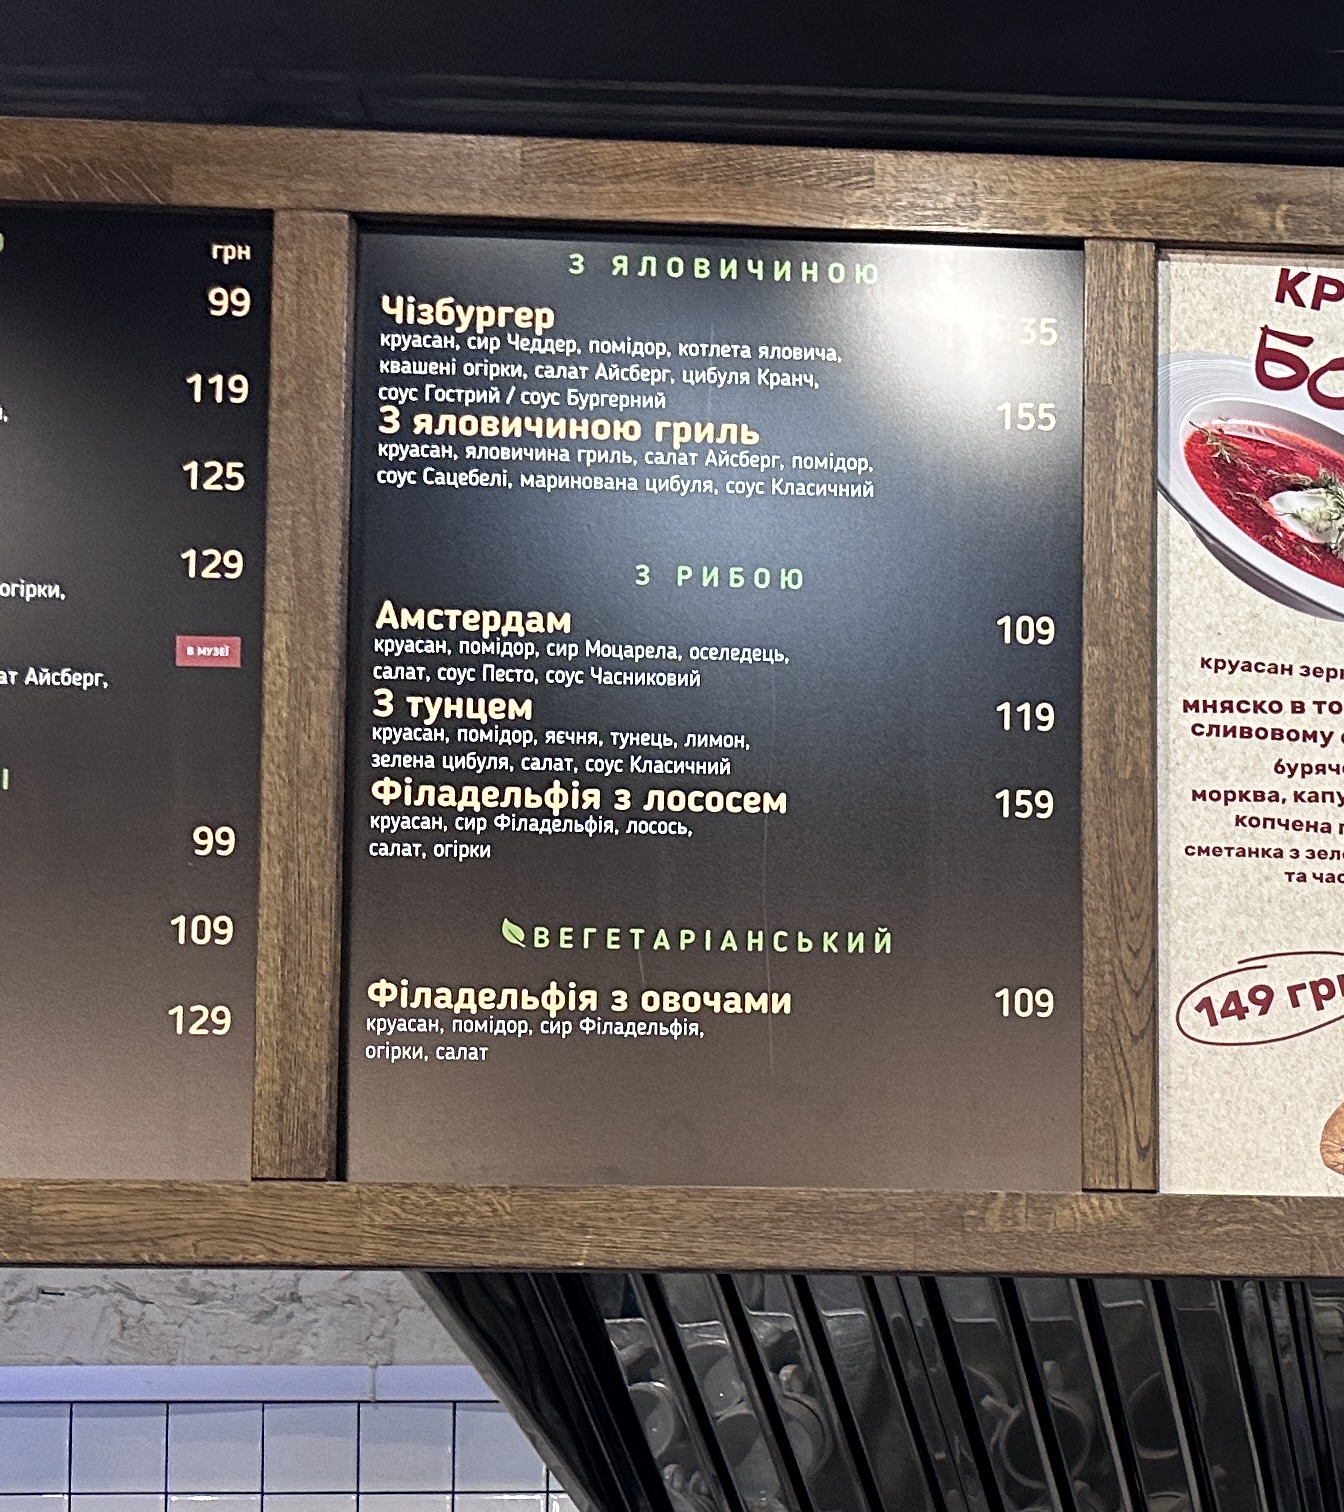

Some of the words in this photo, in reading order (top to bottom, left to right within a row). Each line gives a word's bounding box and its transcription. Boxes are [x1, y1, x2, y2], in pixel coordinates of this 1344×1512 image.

[212, 245, 250, 264] грн
[569, 253, 584, 274] З
[612, 254, 880, 284] ЯЛОВИЧИНОЮ
[208, 287, 250, 316] 99
[382, 295, 554, 336] Чізбургер
[1006, 317, 1058, 346] 35
[381, 333, 460, 351] круасан,
[467, 336, 500, 354] сир
[507, 335, 581, 356] Чеддер,
[589, 340, 671, 359] помідор,
[679, 343, 751, 358] котлета
[759, 346, 841, 363] яловича,
[186, 374, 248, 403] 119
[379, 408, 400, 434] З
[413, 414, 641, 441] яловичиною
[655, 421, 759, 447] гриль
[998, 403, 1057, 431] 155
[183, 461, 244, 491] 125
[377, 470, 417, 488] соус
[423, 469, 512, 489] Сацебелі,
[520, 471, 638, 492] маринована
[646, 474, 718, 496] цибуля,
[726, 480, 765, 498] соус
[772, 478, 874, 497] Класичний
[181, 549, 243, 579] 129
[636, 564, 649, 585] З
[678, 566, 802, 589] РИБОЮ
[375, 601, 570, 639] Амстердам
[997, 616, 1054, 645] 109
[24, 667, 108, 690] Айсберг,
[1201, 657, 1293, 676] круасан
[373, 689, 393, 717] З
[406, 696, 532, 725] тунцем
[997, 702, 1054, 731] 119
[1183, 700, 1283, 714] мняско
[1291, 700, 1305, 714] в
[1191, 723, 1334, 748] сливовому
[371, 754, 435, 768] зелена
[443, 752, 514, 773] цибуля,
[521, 757, 578, 773] салат,
[586, 758, 623, 776] соус
[630, 755, 730, 775] Класичний
[372, 777, 600, 816] Філадельфія
[614, 789, 631, 810] з
[643, 790, 786, 814] лососем
[996, 789, 1053, 818] 159
[1192, 790, 1287, 806] морква,
[1235, 815, 1331, 834] копчена
[193, 826, 235, 856] 99
[1185, 846, 1283, 858] сметанка
[1290, 848, 1299, 859] з
[1284, 872, 1307, 882] та
[171, 915, 233, 945] 109
[534, 927, 891, 953] ВЕГЕТАРІАНСЬКИЙ
[368, 979, 597, 1018] Філадельфія
[611, 990, 628, 1011] з
[641, 991, 791, 1014] овочами
[995, 988, 1053, 1017] 109
[1195, 984, 1274, 1027] 149
[169, 1005, 231, 1035] 129
[367, 1018, 444, 1036] круасан,
[452, 1015, 532, 1037] помідор,
[541, 1021, 572, 1038] сир
[579, 1017, 704, 1040] Філадельфія,
[366, 1041, 428, 1063] огірки,
[436, 1047, 488, 1060] салат
